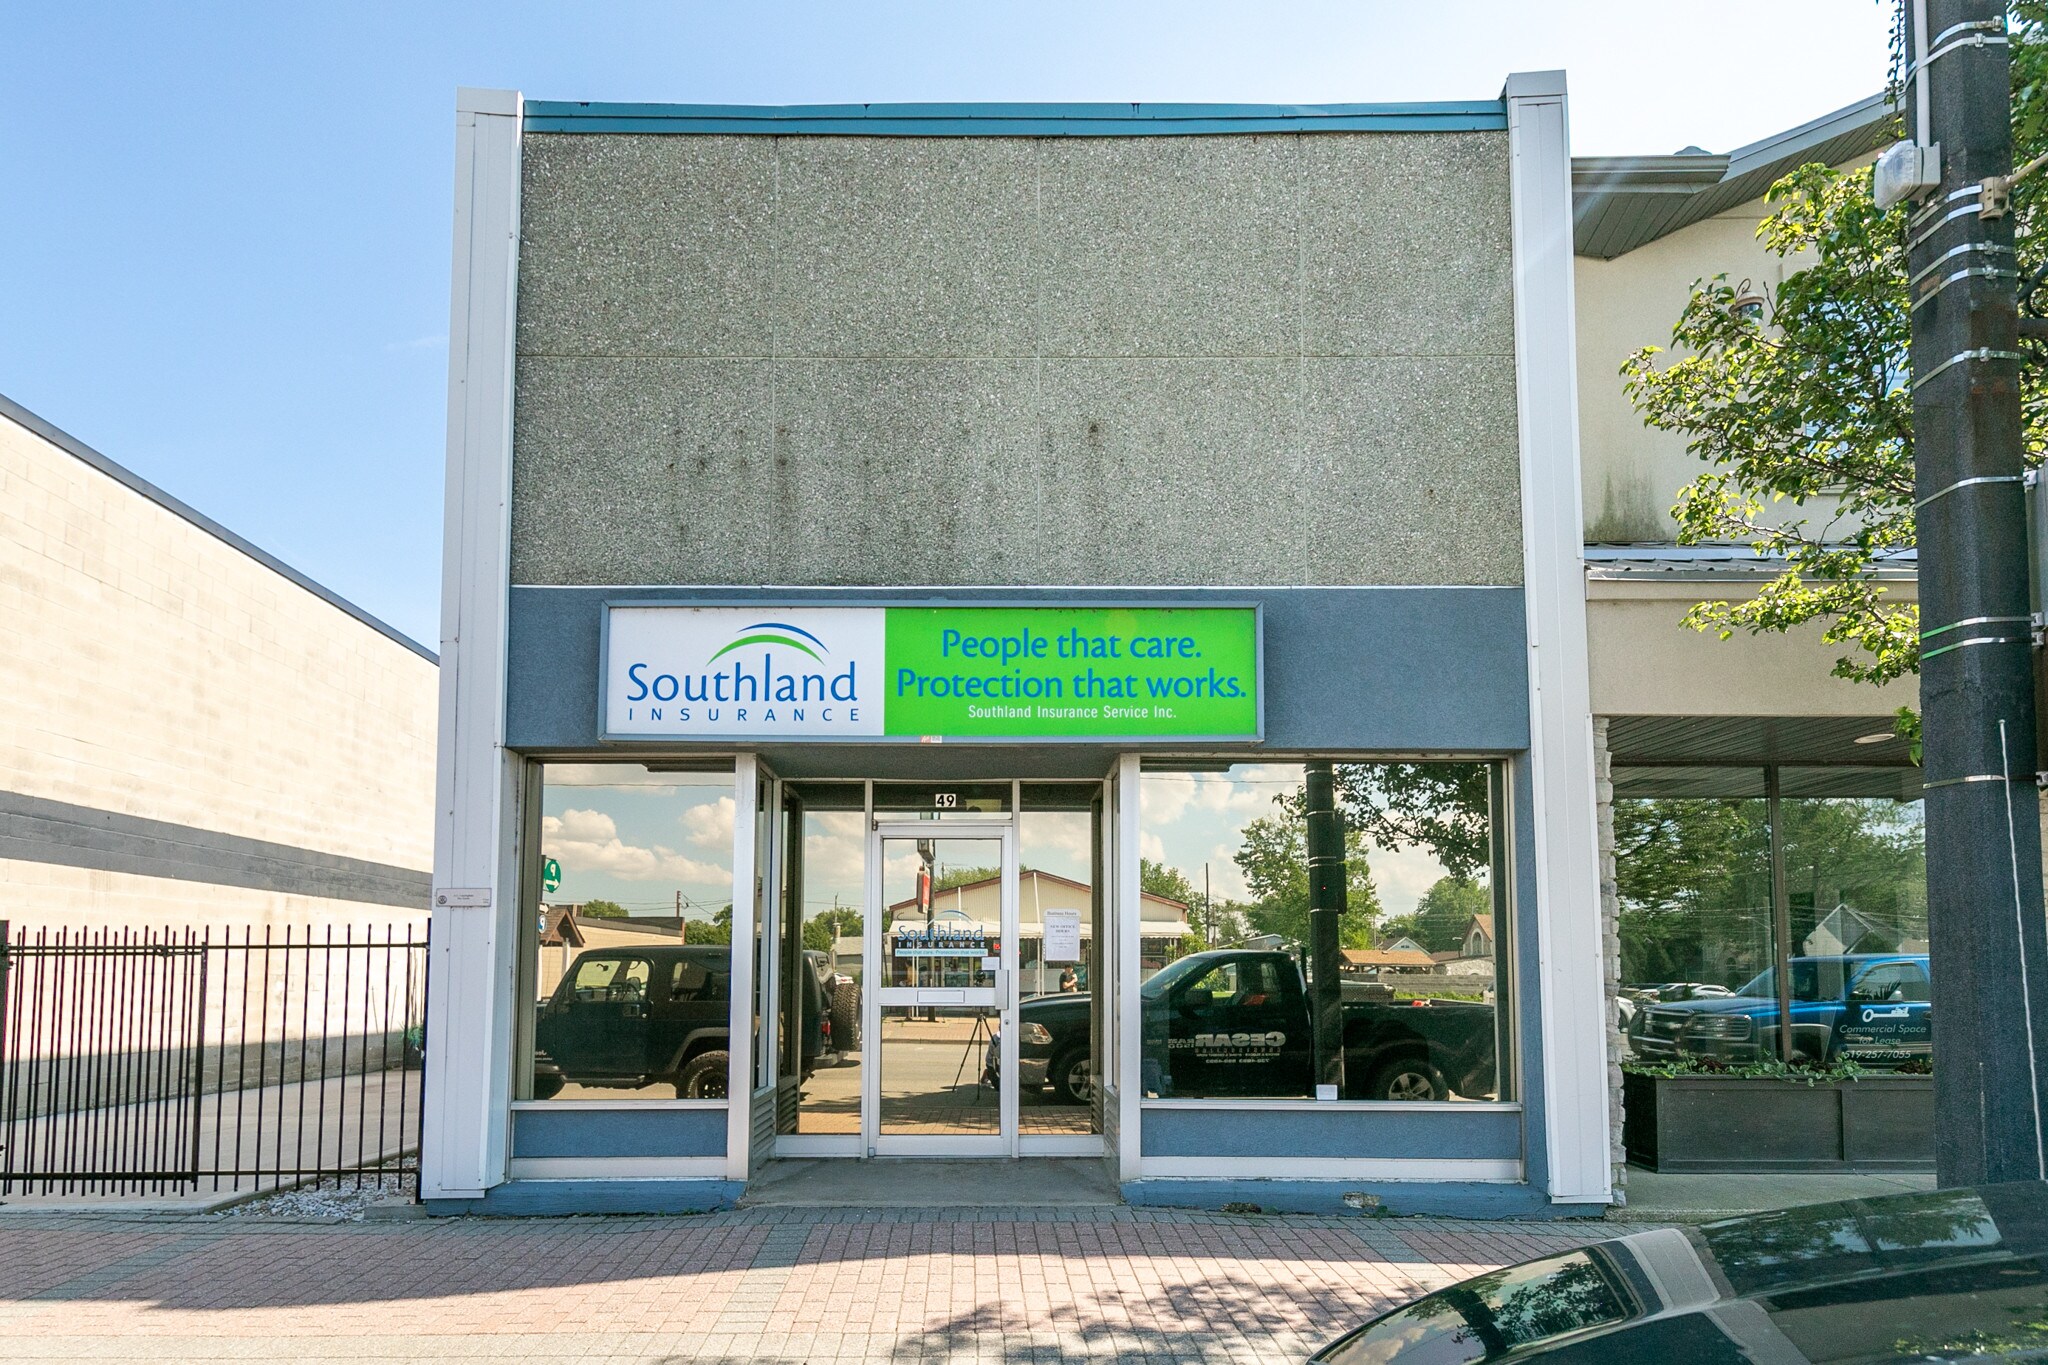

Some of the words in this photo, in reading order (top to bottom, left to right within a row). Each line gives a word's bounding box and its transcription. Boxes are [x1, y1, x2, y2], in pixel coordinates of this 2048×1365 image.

[942, 627, 1049, 666] People
[1056, 627, 1122, 658] that
[1129, 637, 1202, 659] care.
[626, 653, 858, 702] Southland
[897, 668, 1063, 698] Protection
[1072, 668, 1138, 698] that
[1145, 667, 1247, 698] works.
[628, 708, 860, 722] INSURANCE
[968, 705, 1032, 718] Southland
[1037, 705, 1098, 718] Insurance
[1103, 705, 1149, 718] Service
[1154, 705, 1177, 719] Inc.
[936, 795, 955, 807] 49
[897, 921, 985, 941] Southland
[1839, 1024, 1897, 1034] Commercial
[1898, 1024, 1927, 1035] Space
[1859, 1035, 1872, 1045] for
[1874, 1036, 1902, 1045] Lease
[1843, 1050, 1911, 1059] 519-257-7055
